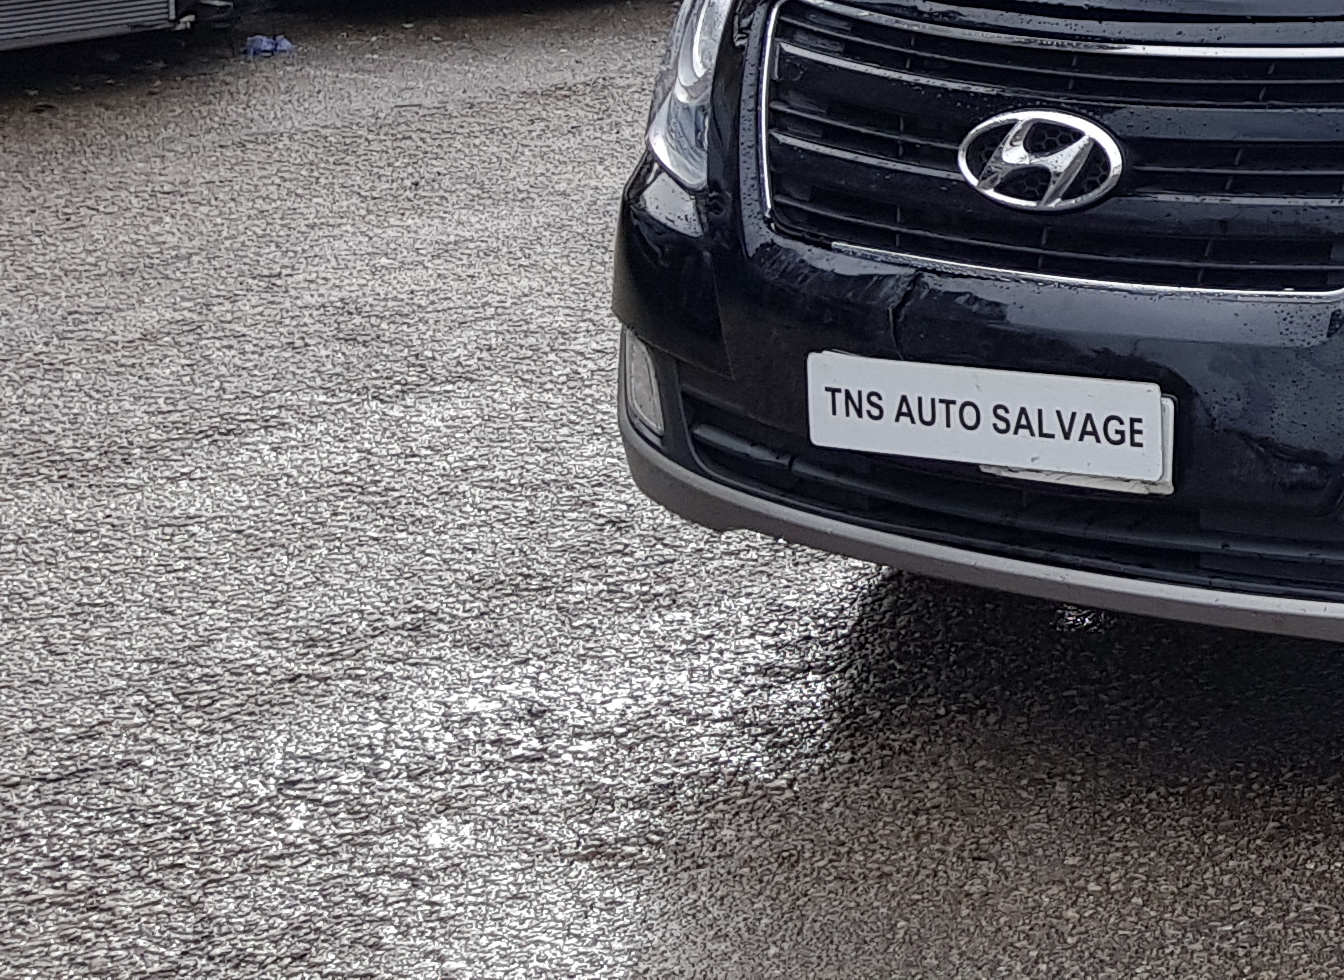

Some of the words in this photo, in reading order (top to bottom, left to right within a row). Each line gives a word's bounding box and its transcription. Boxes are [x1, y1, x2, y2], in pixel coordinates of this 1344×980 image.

[824, 386, 884, 421] TNS
[894, 394, 981, 431] AUTO
[992, 404, 1144, 448] SALVAGE
